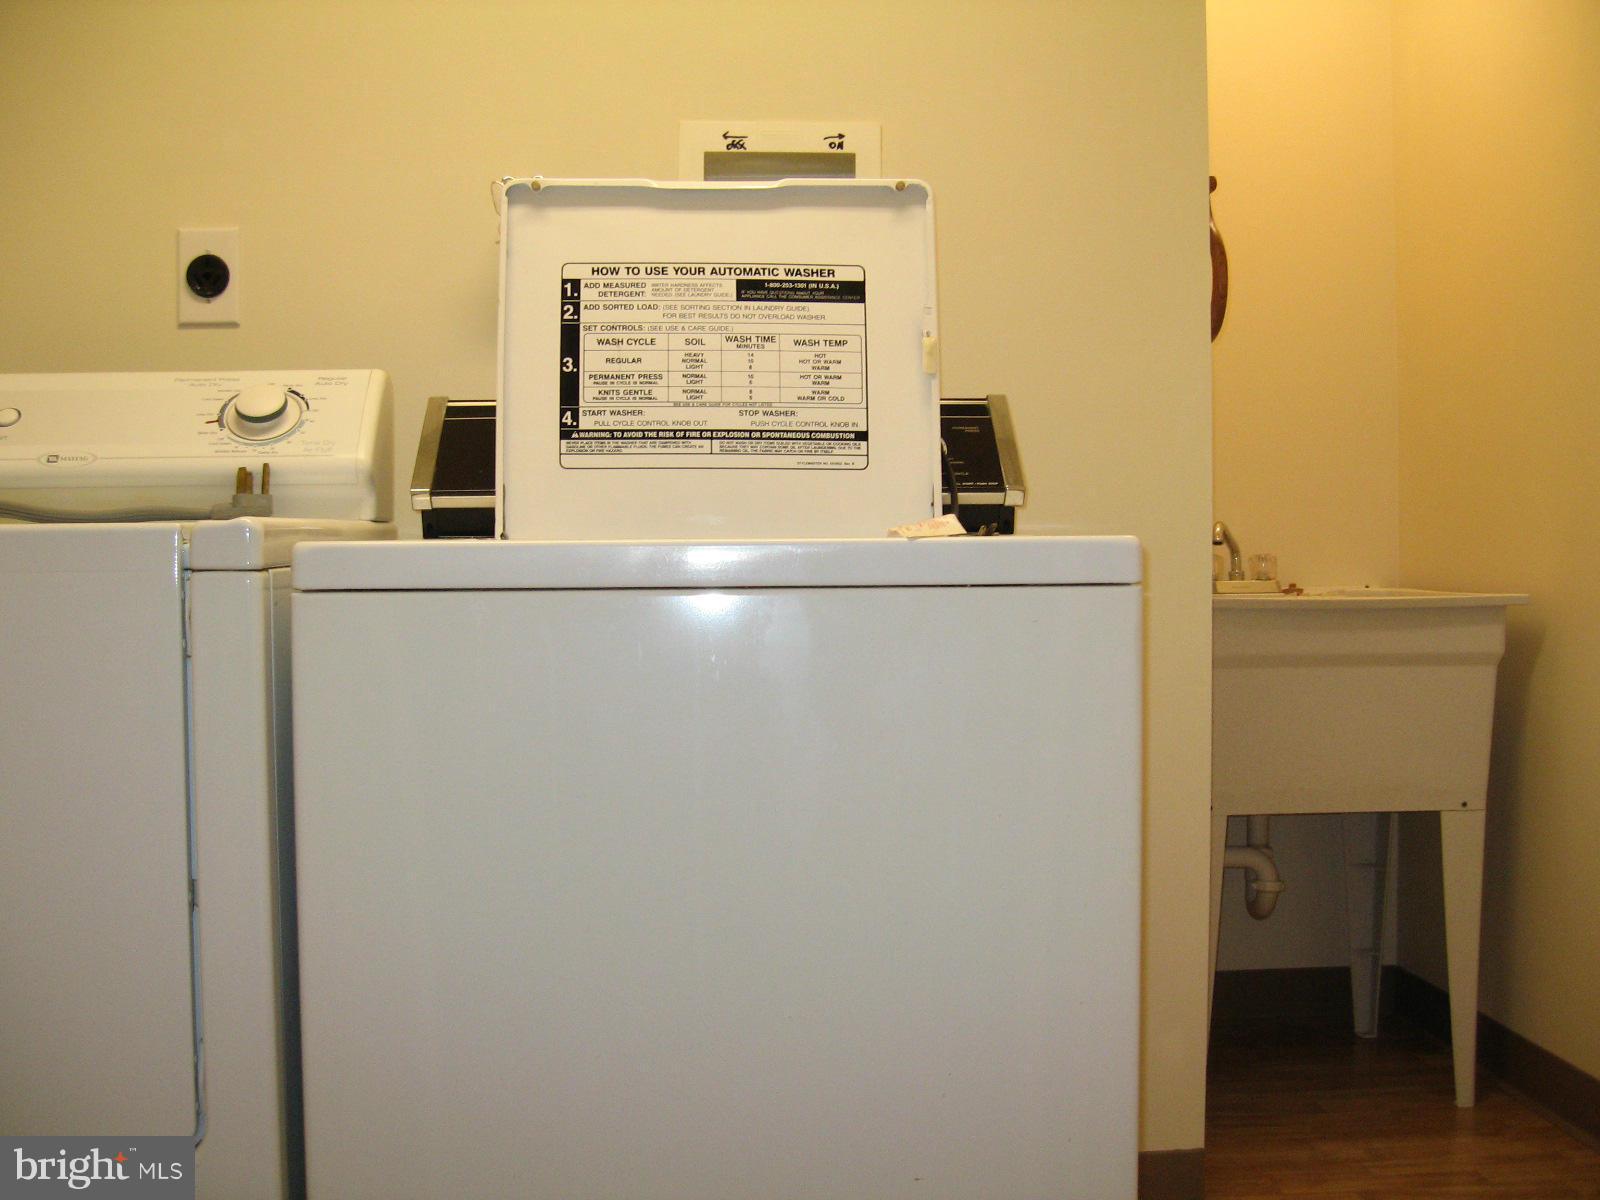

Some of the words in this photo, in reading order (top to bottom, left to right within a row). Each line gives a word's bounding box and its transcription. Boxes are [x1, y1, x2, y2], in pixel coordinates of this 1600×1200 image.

[591, 267, 620, 275] HOW
[624, 267, 640, 275] TO
[645, 267, 668, 275] USE
[673, 267, 705, 275] YOUR
[710, 267, 779, 277] AUTOMATIC
[784, 268, 835, 278] WASHER
[564, 282, 578, 297] 1.
[563, 305, 578, 319] 2.
[562, 358, 578, 372] 3.
[561, 411, 577, 426] 4.
